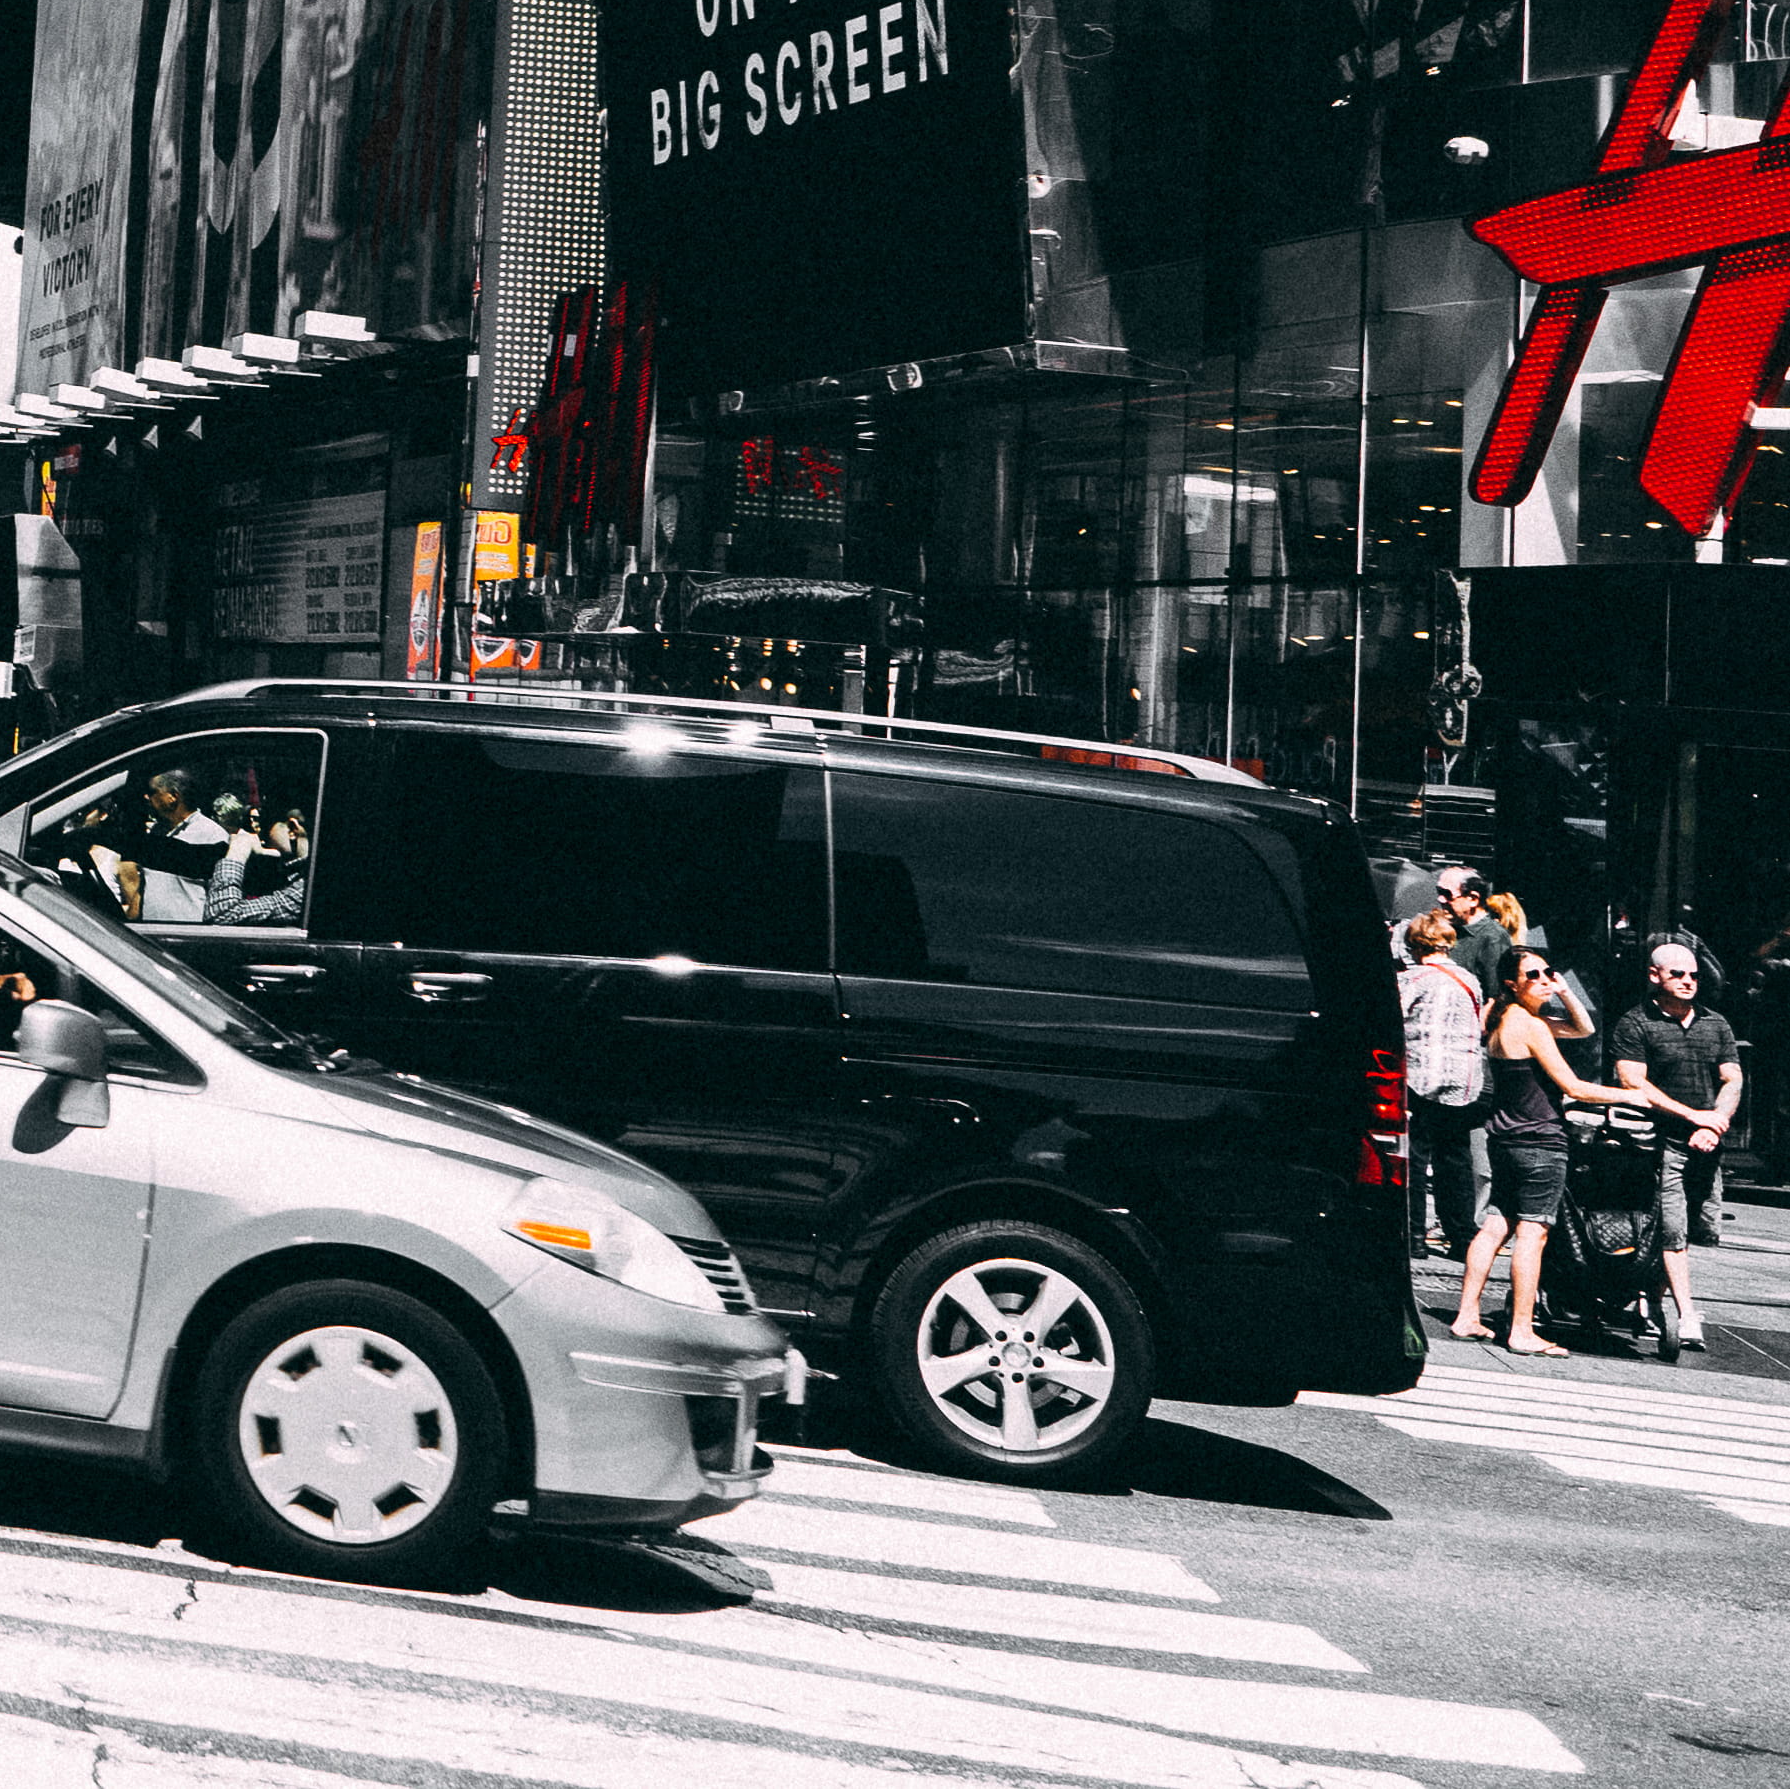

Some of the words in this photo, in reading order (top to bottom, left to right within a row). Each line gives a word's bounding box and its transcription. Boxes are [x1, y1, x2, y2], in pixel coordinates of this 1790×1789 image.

[649, 70, 721, 167] BIG
[40, 200, 62, 242] FOR
[64, 178, 104, 231] EVERY
[43, 244, 92, 298] VICTORY
